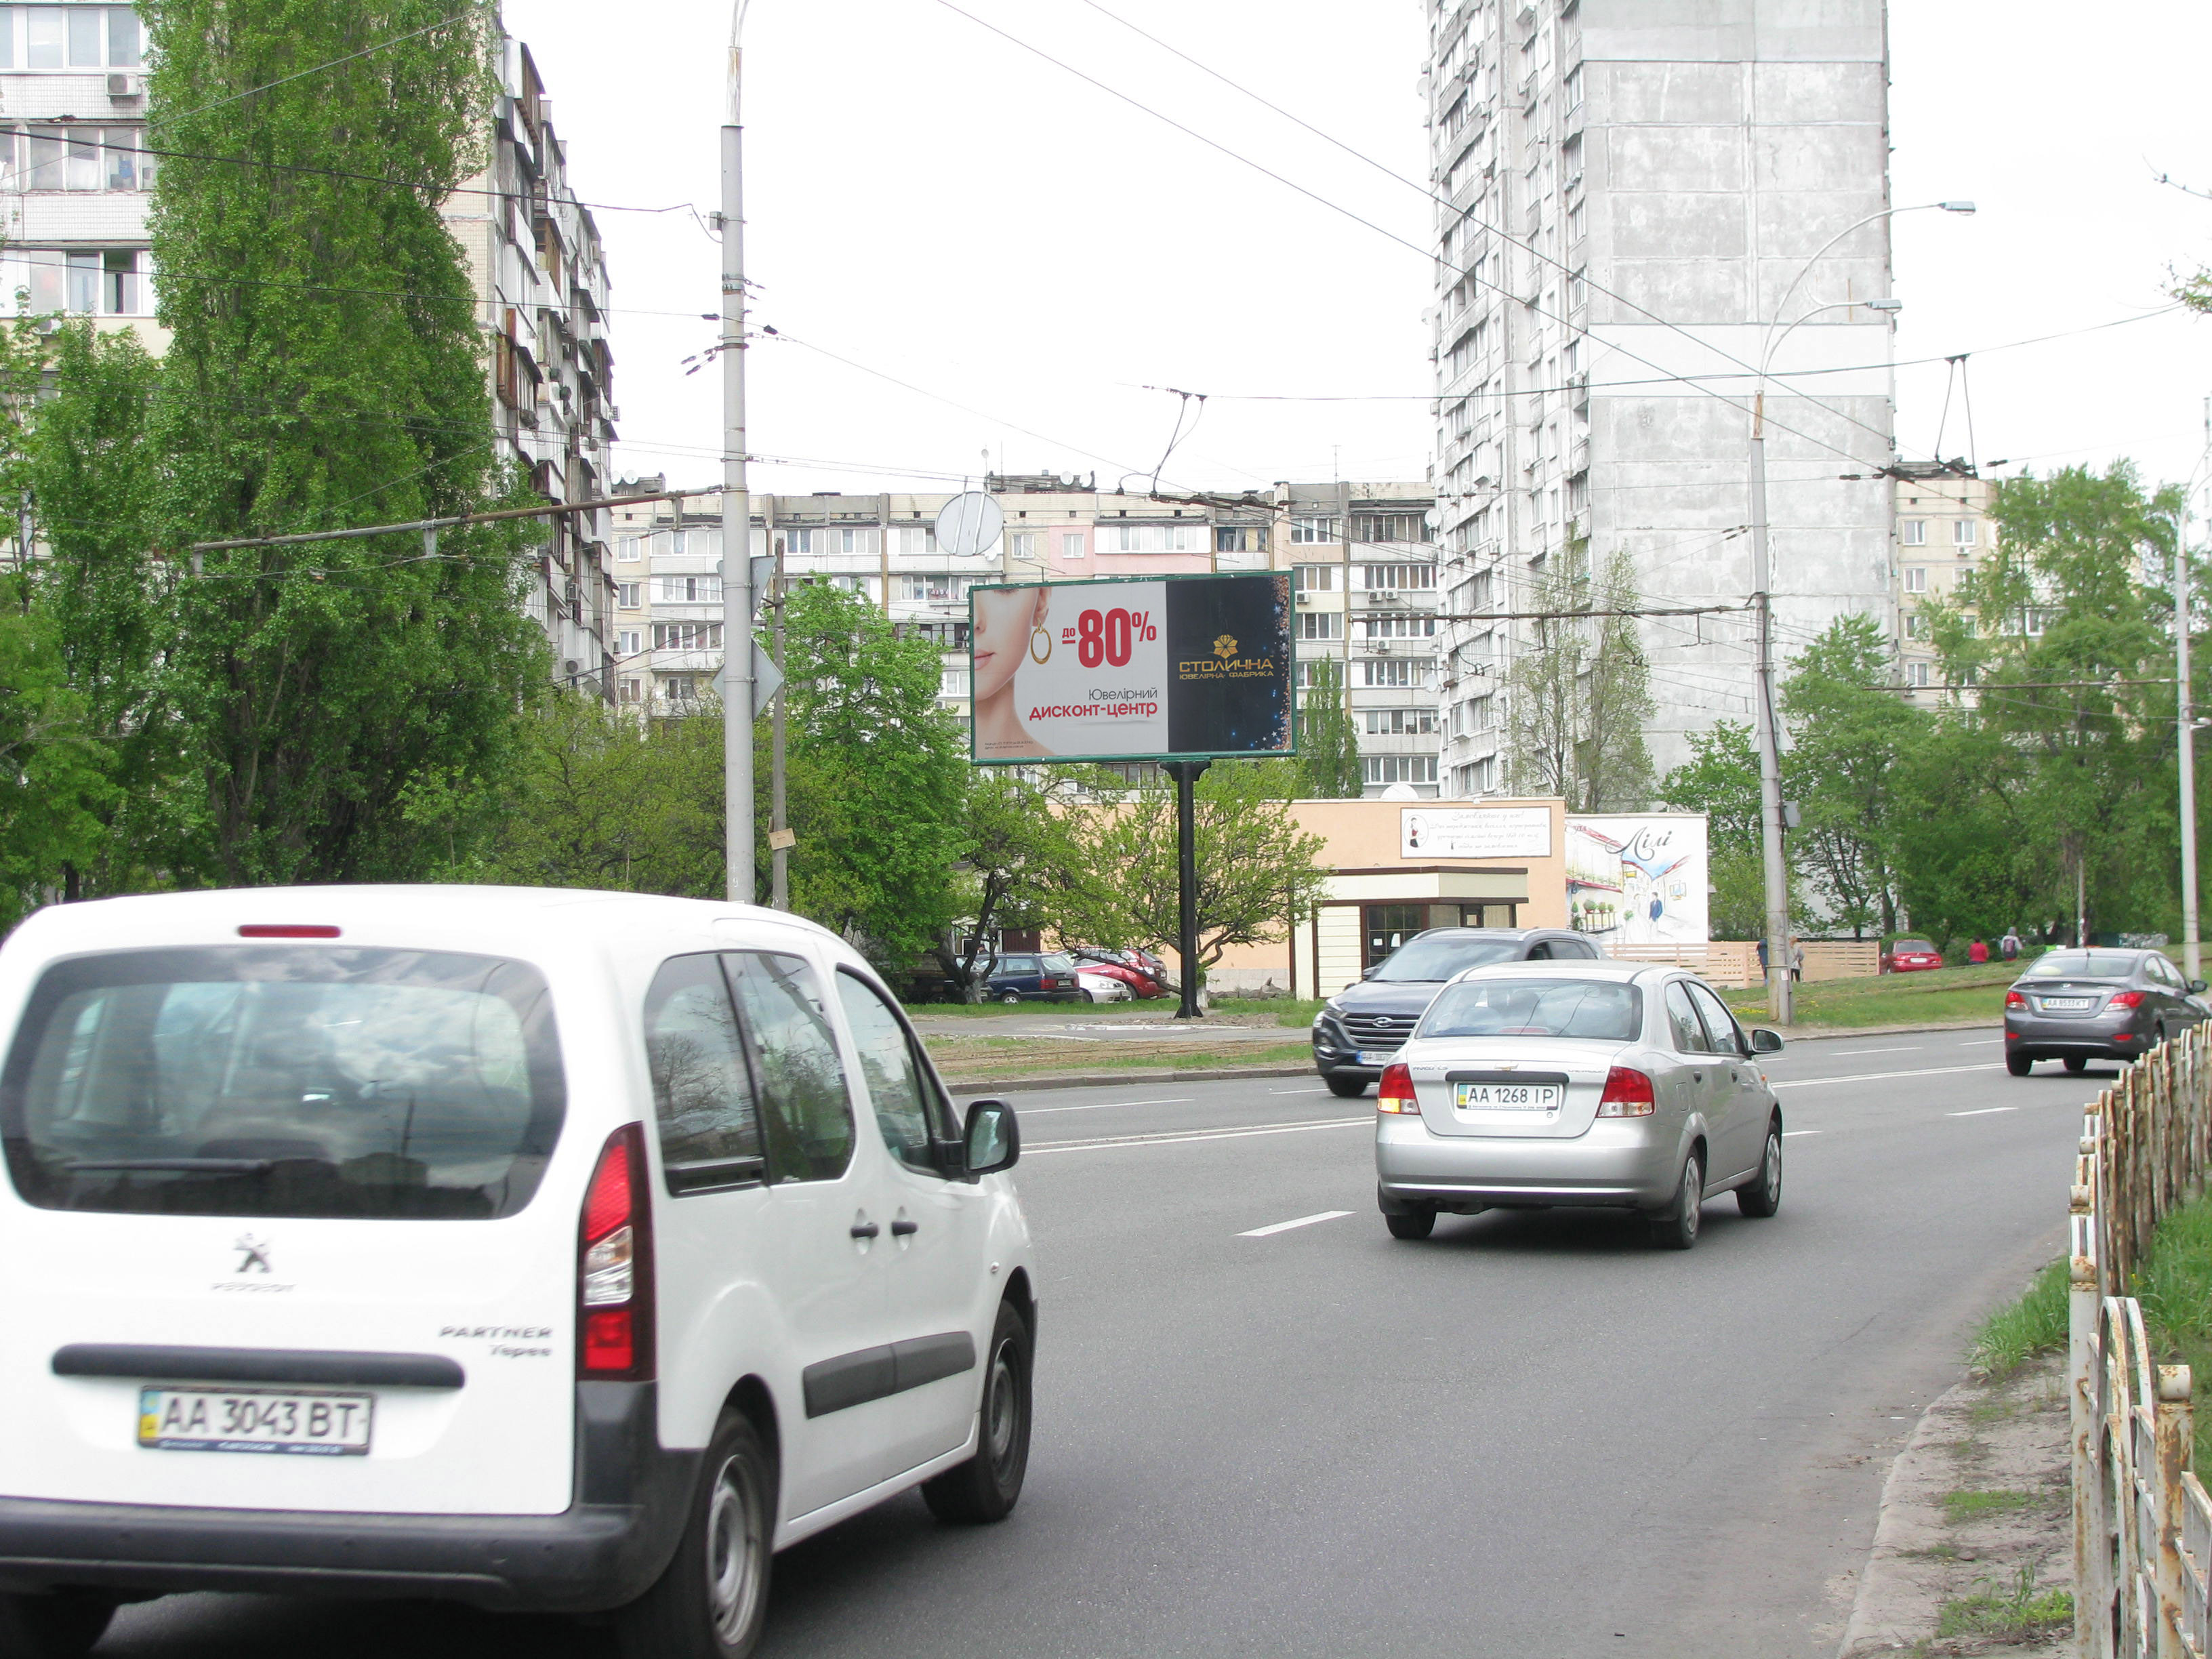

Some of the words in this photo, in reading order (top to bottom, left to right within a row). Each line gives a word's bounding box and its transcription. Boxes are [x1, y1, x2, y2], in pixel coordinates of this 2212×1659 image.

[1179, 658, 1274, 672] СТОЛИЧНА
[1179, 672, 1225, 680] ЮВЕЛІРНА
[1229, 670, 1274, 678] ФАБРИКА
[1088, 687, 1158, 702] Ювелірний
[1468, 1087, 1490, 1103] AA
[1494, 1087, 1528, 1103] 1268
[1534, 1088, 1554, 1104] IP
[438, 1325, 554, 1338] PARTNER
[489, 1343, 553, 1359] Tepee
[161, 1396, 210, 1435] AA
[222, 1397, 299, 1436] 3043
[308, 1401, 360, 1438] BT
